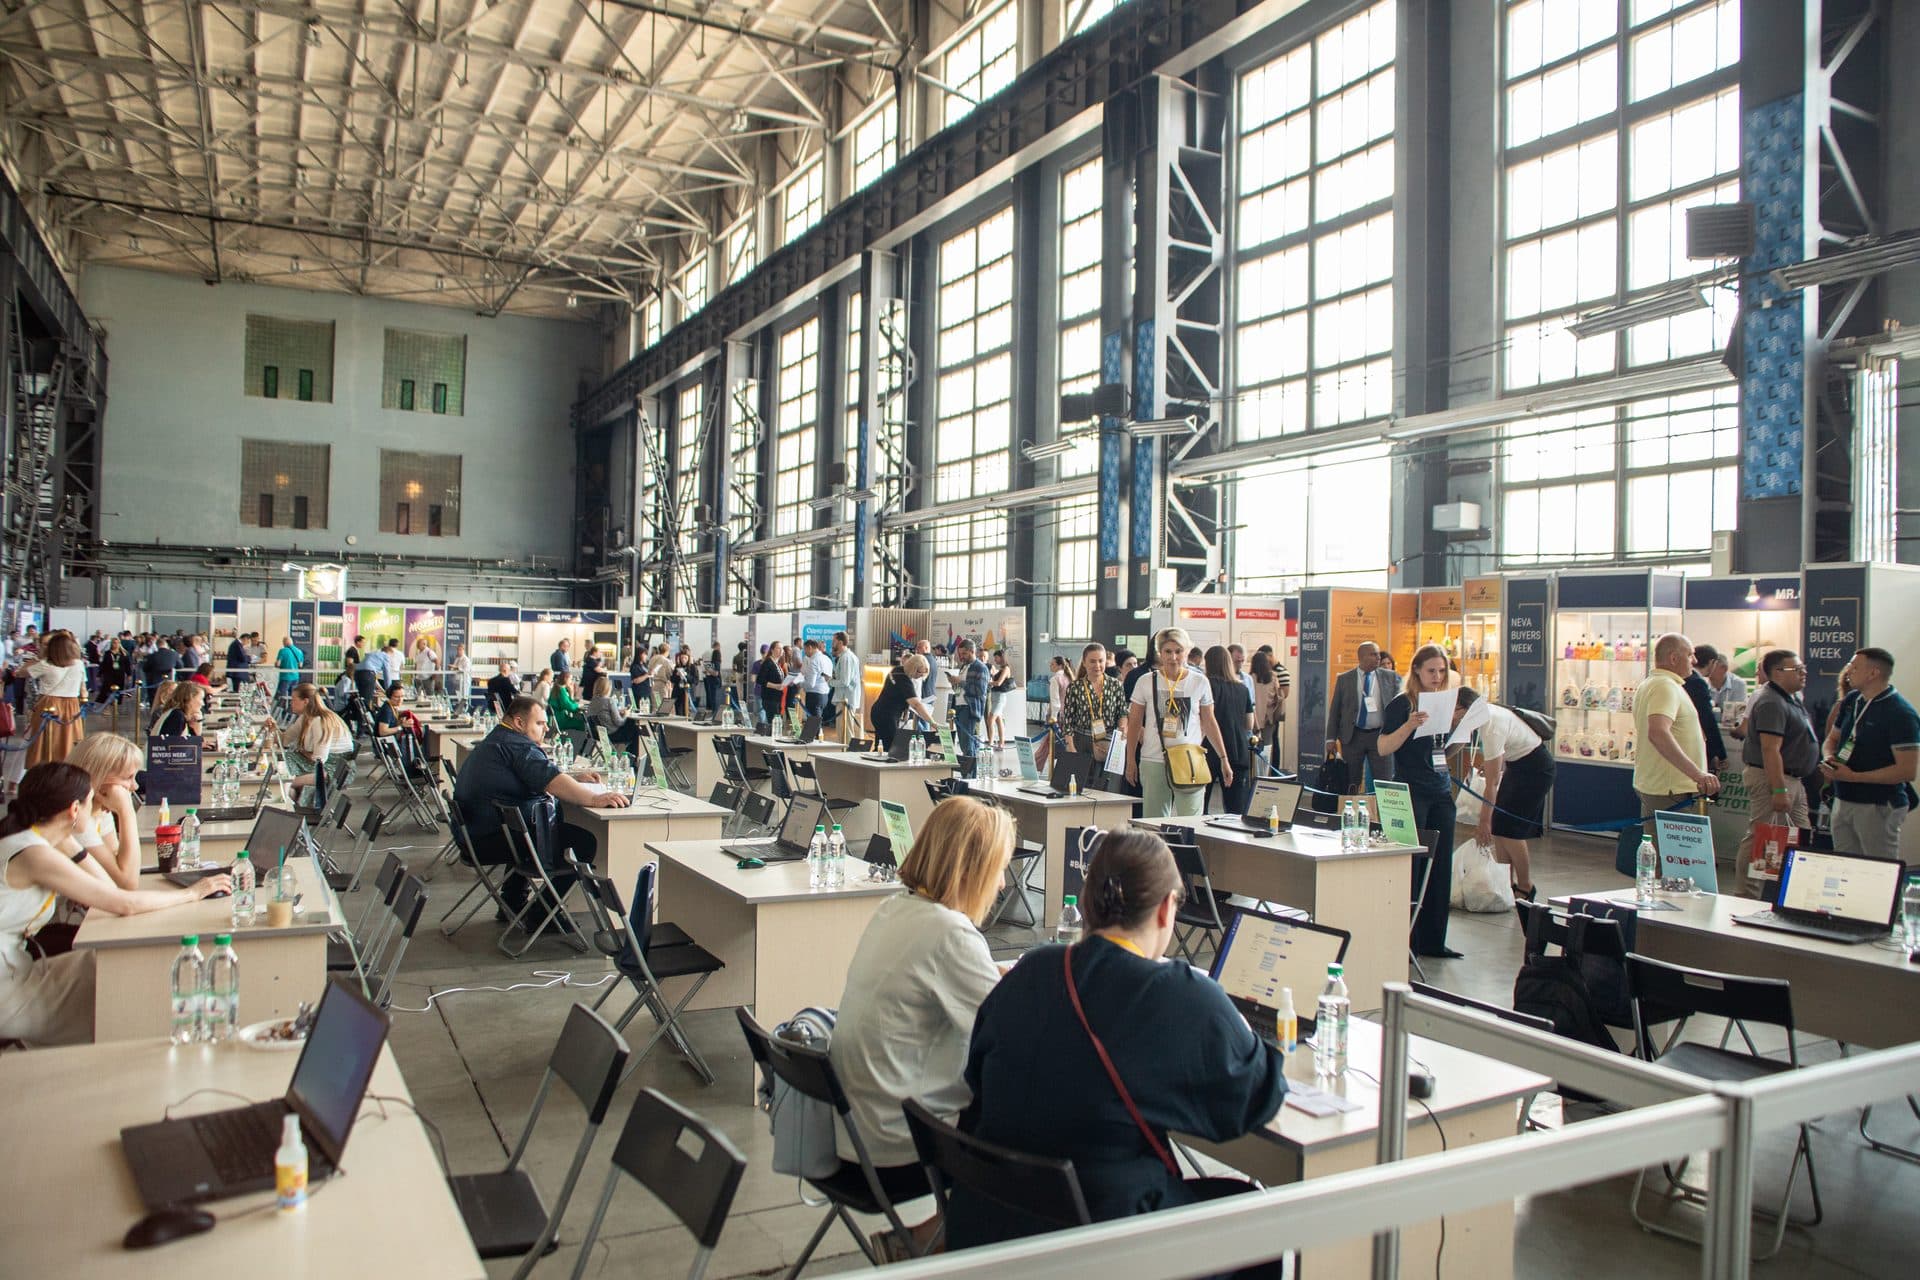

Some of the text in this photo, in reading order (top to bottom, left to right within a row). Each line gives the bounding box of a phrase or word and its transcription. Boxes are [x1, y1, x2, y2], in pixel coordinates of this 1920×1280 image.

[1302, 621, 1318, 629] NEVA
[1511, 617, 1532, 627] NEVA
[1809, 616, 1841, 627] NEVA
[1302, 632, 1324, 641] BUYERS
[1511, 631, 1541, 640] BUYERS
[1809, 631, 1855, 643] BUYERS
[1302, 643, 1318, 651] WEEK
[1511, 643, 1533, 653] WEEK
[1809, 647, 1841, 659] WEEK
[1663, 823, 1703, 833] NONFOOD
[1666, 833, 1703, 844] ONE PRICE
